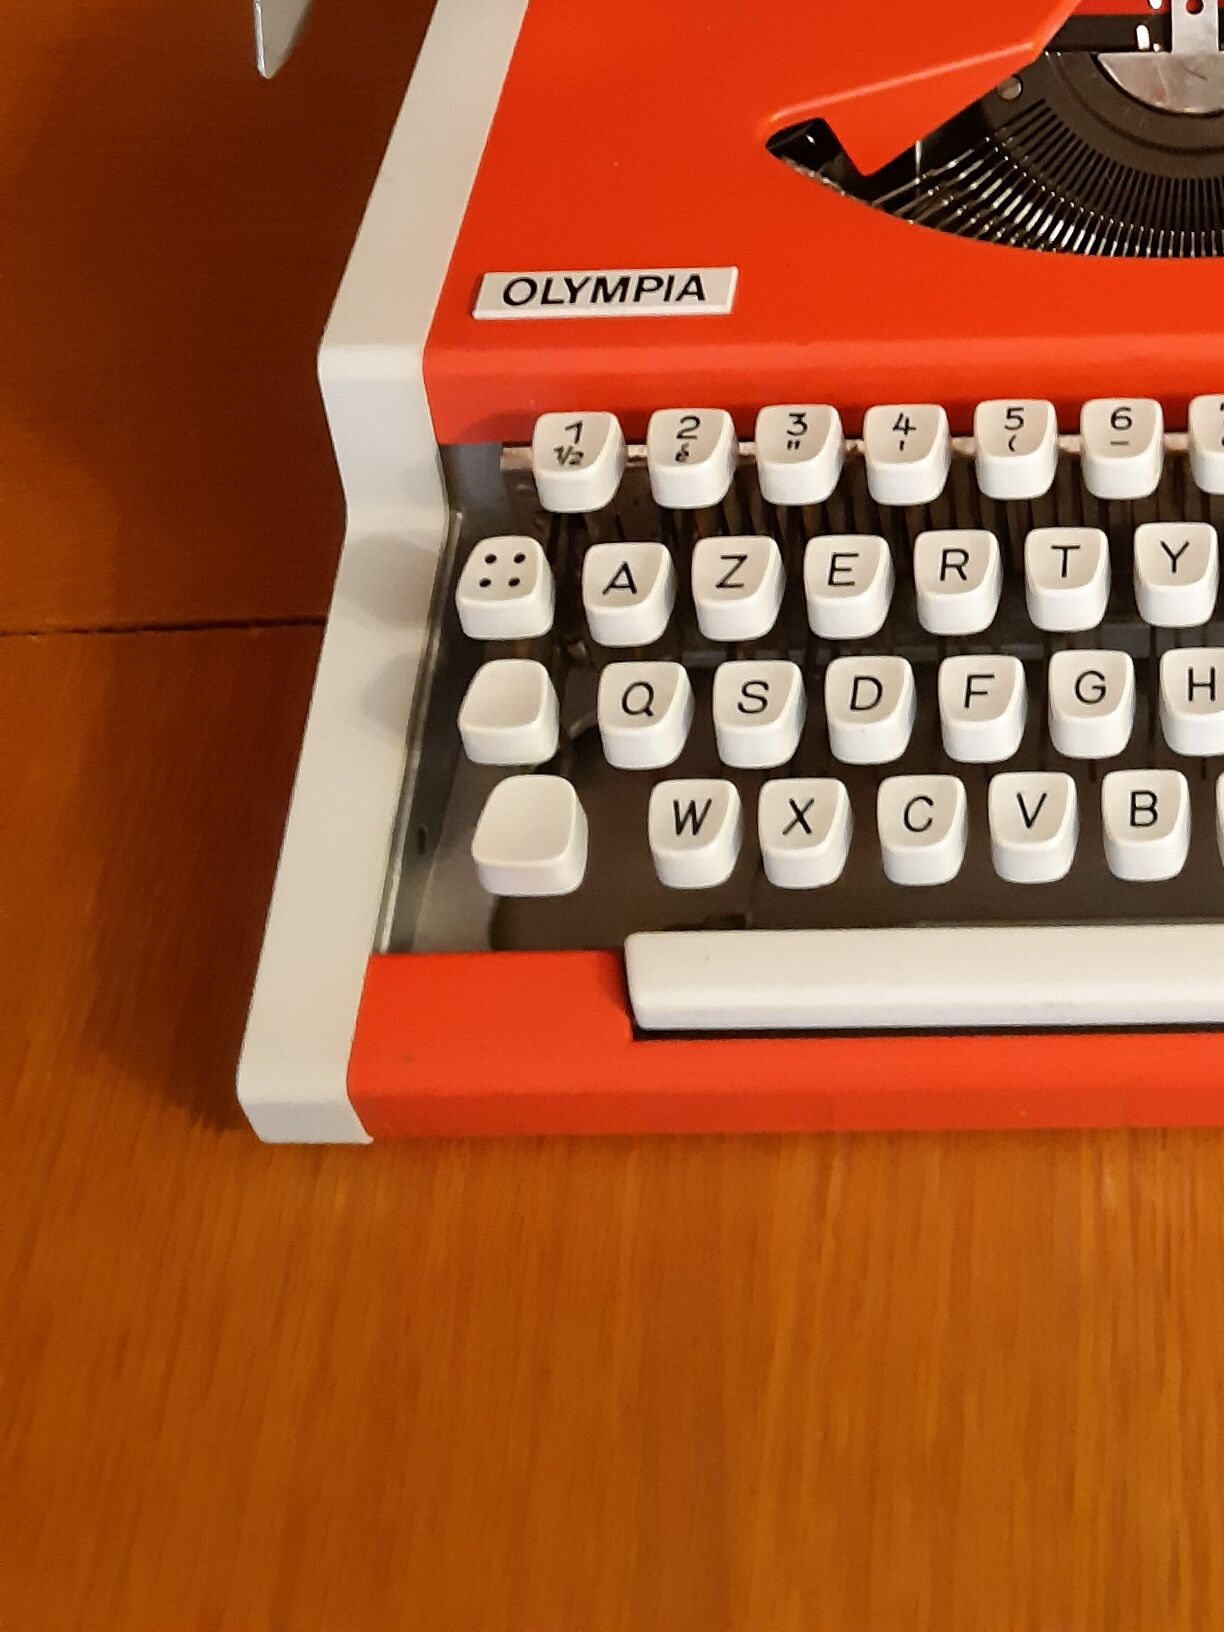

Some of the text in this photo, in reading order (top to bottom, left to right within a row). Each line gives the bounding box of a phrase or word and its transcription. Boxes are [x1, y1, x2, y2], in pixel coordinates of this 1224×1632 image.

[503, 274, 705, 306] OLYMPIA
[564, 420, 584, 444] 1
[676, 415, 701, 440] 2
[786, 412, 808, 437] 3
[892, 412, 918, 436] 4
[1004, 406, 1025, 431] 5
[1110, 406, 1133, 431] 6
[715, 554, 748, 590] Z
[827, 552, 859, 588] E
[939, 548, 970, 582] R
[1050, 544, 1081, 579] T
[1160, 541, 1190, 574] Y
[601, 560, 638, 596] A
[621, 681, 655, 717] Q
[737, 680, 770, 715] S
[849, 675, 883, 712] D
[963, 673, 996, 710] F
[1074, 670, 1107, 705] G
[1187, 666, 1216, 702] H
[672, 798, 713, 837] W
[782, 798, 815, 836] X
[903, 795, 934, 833] C
[1016, 792, 1048, 830] V
[1129, 790, 1159, 828] B
